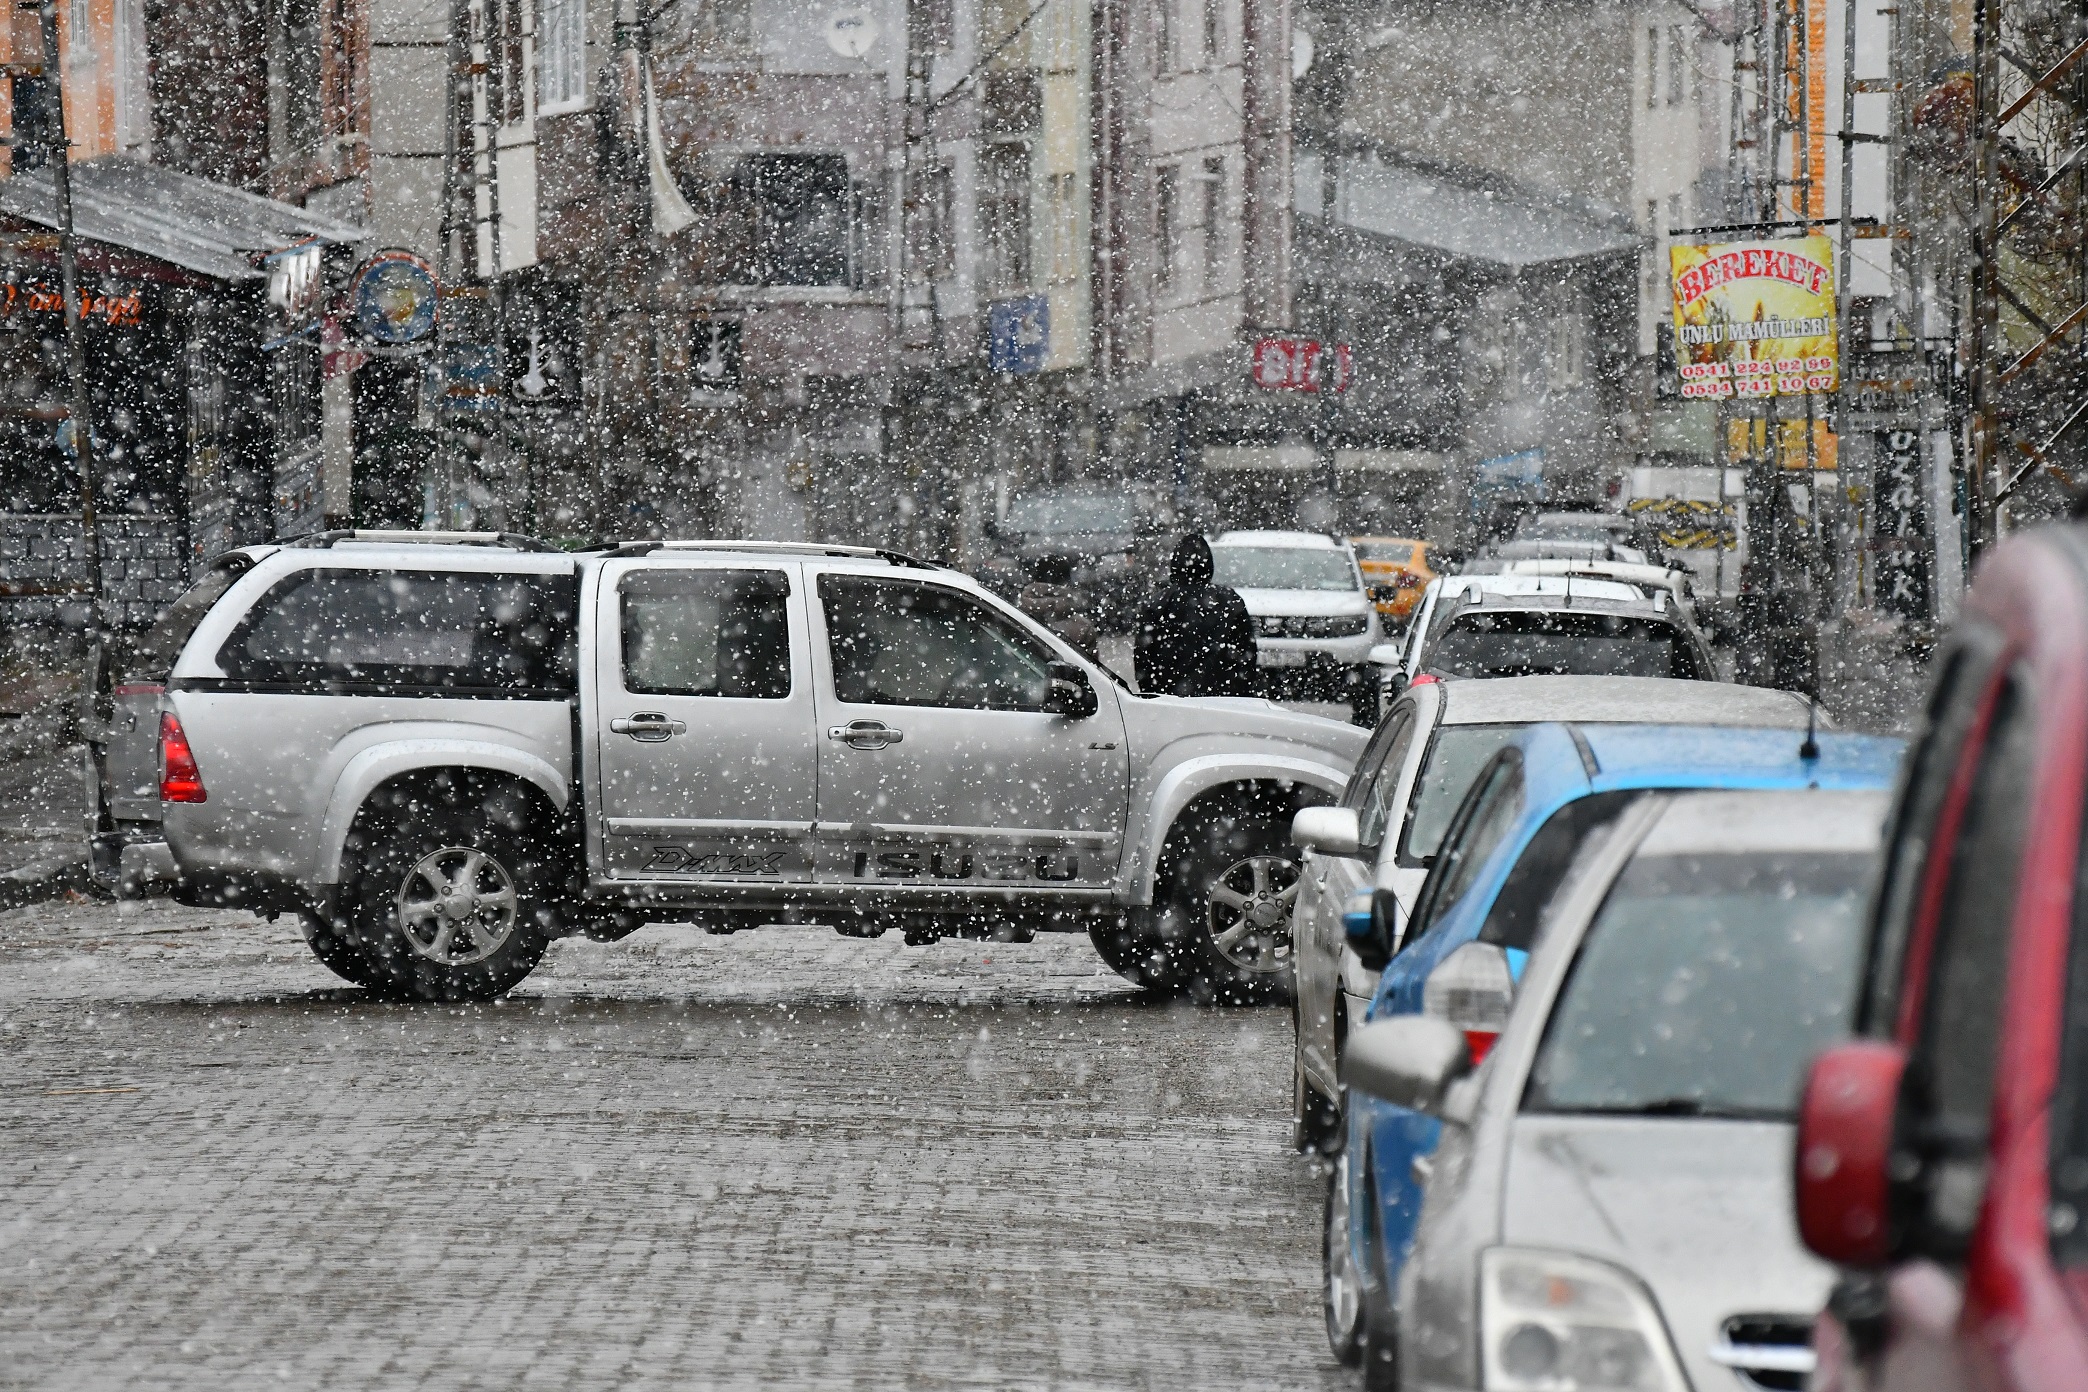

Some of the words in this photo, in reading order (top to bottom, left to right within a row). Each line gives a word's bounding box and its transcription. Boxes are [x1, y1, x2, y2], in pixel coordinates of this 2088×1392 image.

[1678, 249, 1829, 305] BEREKET
[1729, 312, 1830, 341] MAMÜLLERİ
[1681, 363, 1728, 379] 0541
[1735, 361, 1772, 376] 224
[1682, 382, 1731, 397] 0534
[1736, 379, 1771, 394] 741
[1780, 376, 1803, 391] 10
[1808, 374, 1833, 390] 67
[853, 852, 1079, 882] ISUZU
